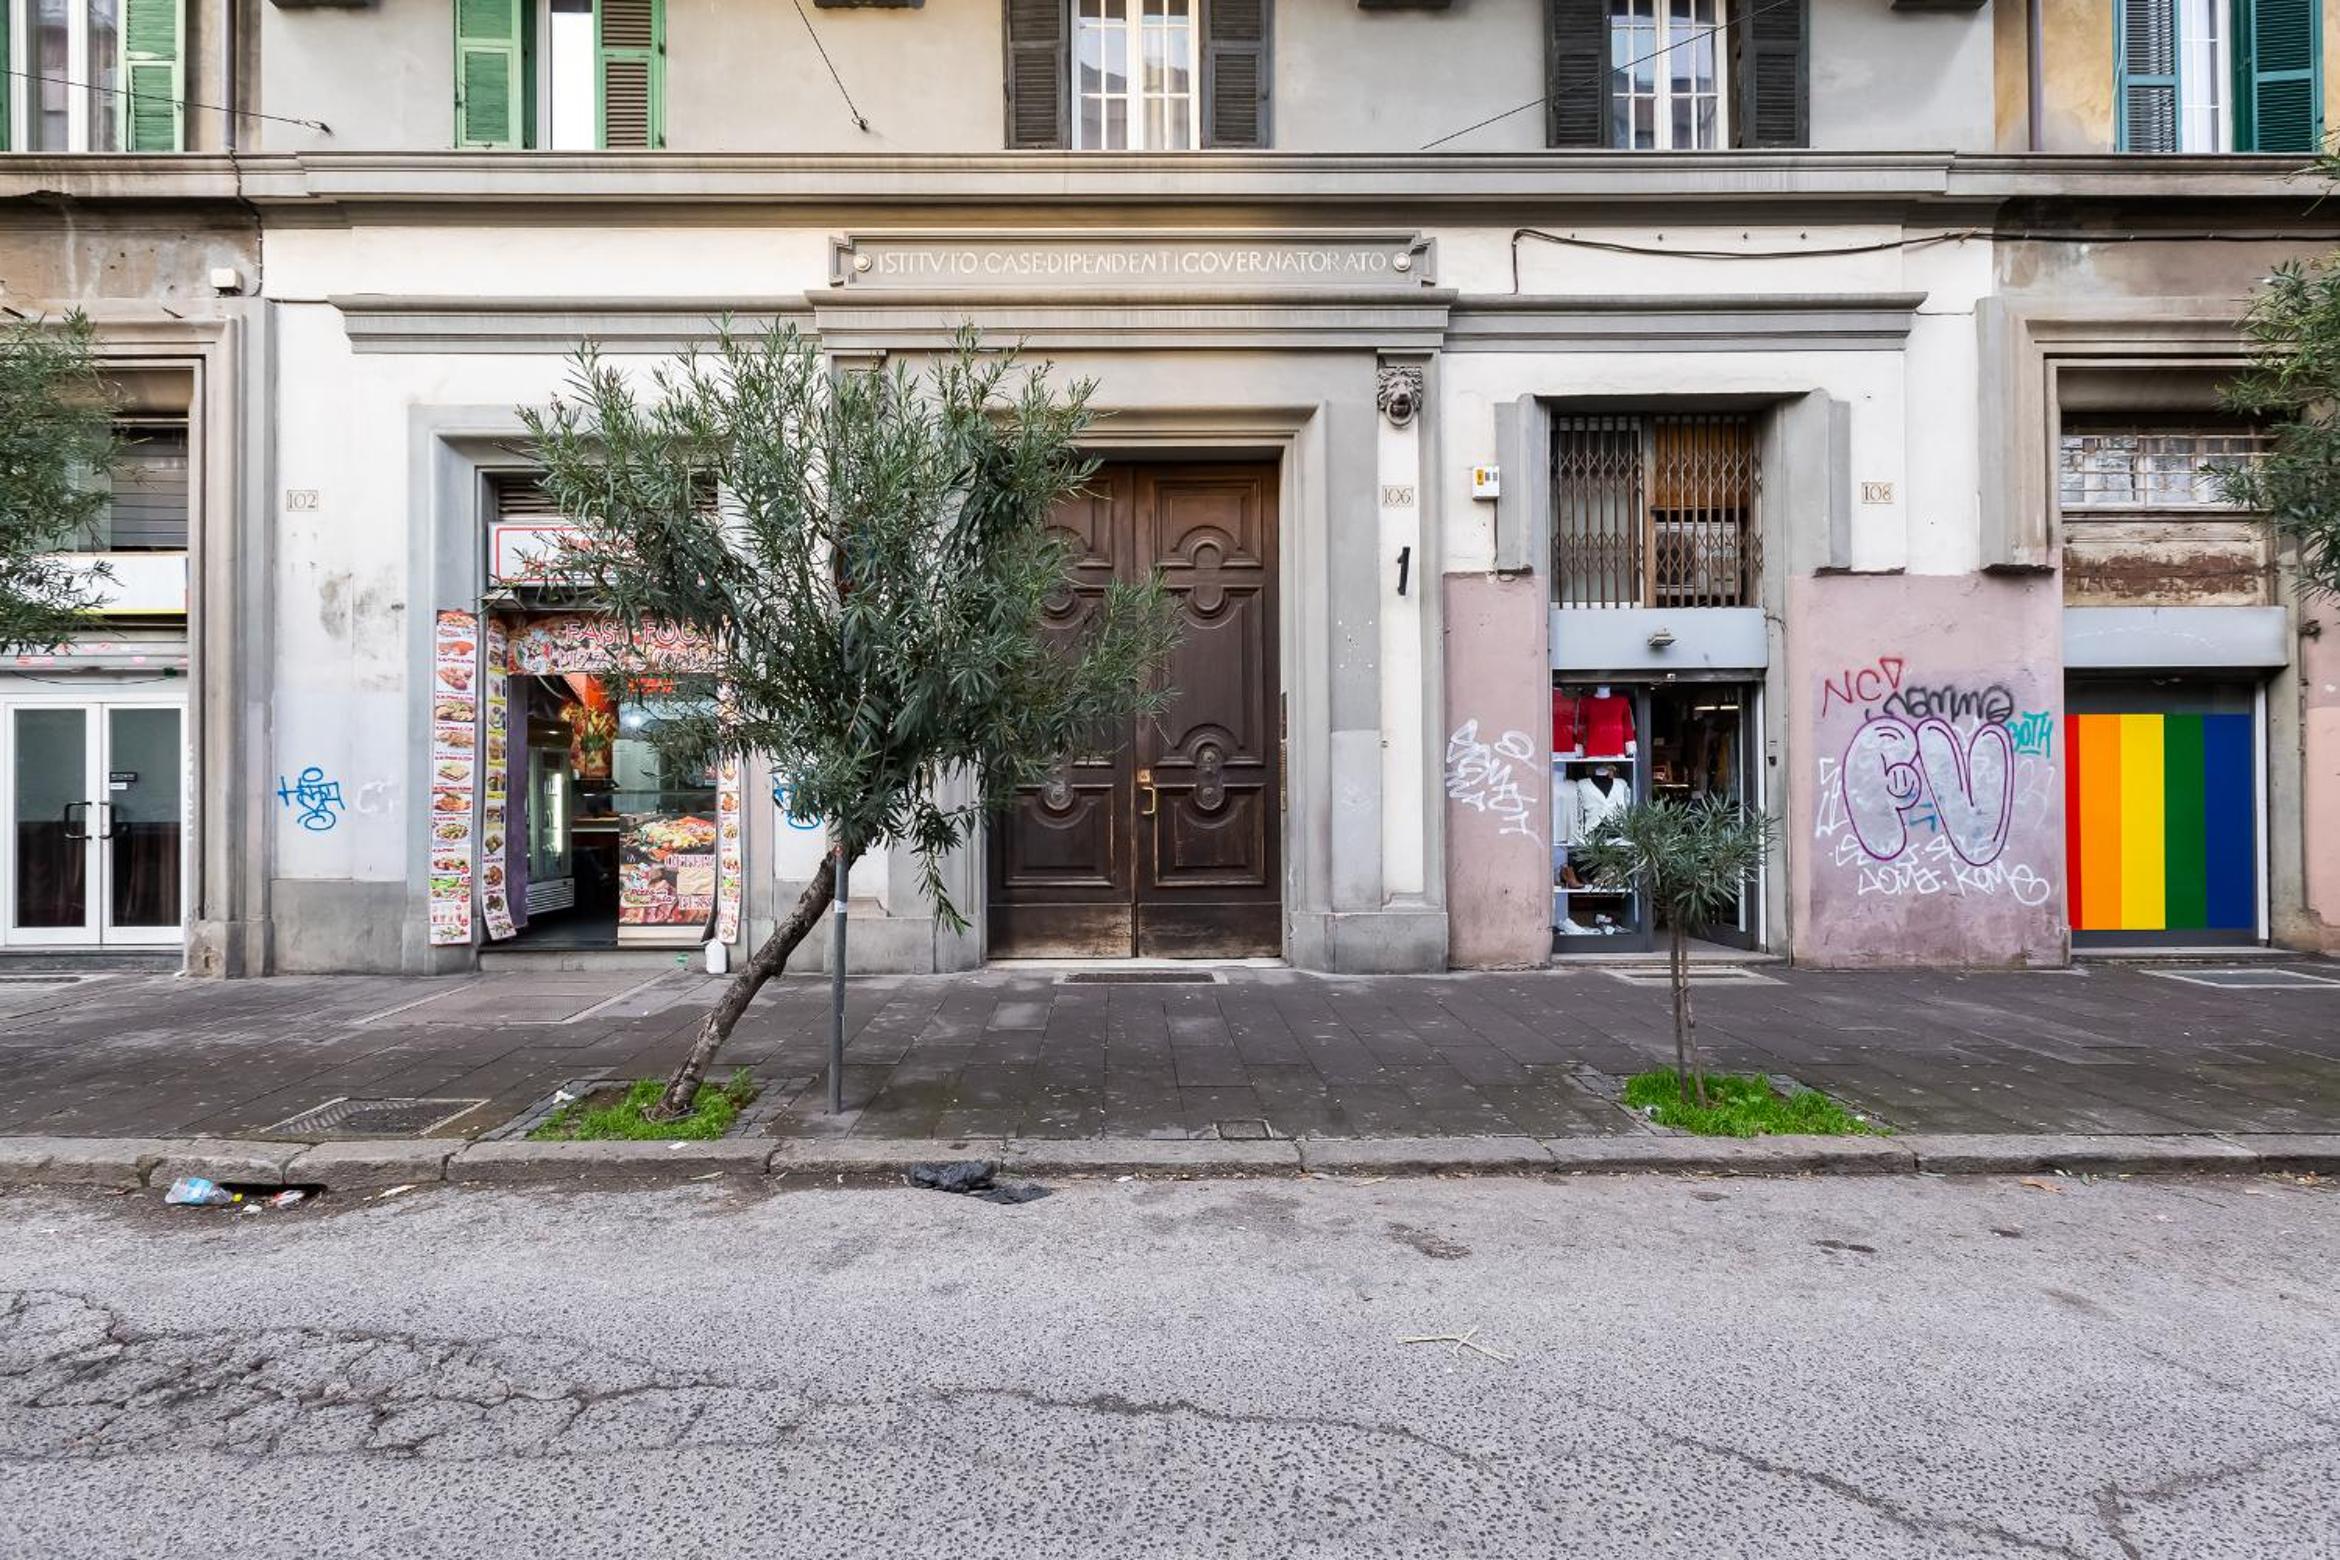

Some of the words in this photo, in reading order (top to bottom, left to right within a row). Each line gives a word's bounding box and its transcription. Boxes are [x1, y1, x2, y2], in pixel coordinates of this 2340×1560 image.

[985, 252, 1043, 274] CASE
[1047, 252, 1179, 274] DIPENDENTI
[1182, 251, 1387, 273] GOVERNATORATO
[289, 492, 316, 509] 102
[1384, 487, 1411, 504] 106
[1864, 484, 1891, 501] 108
